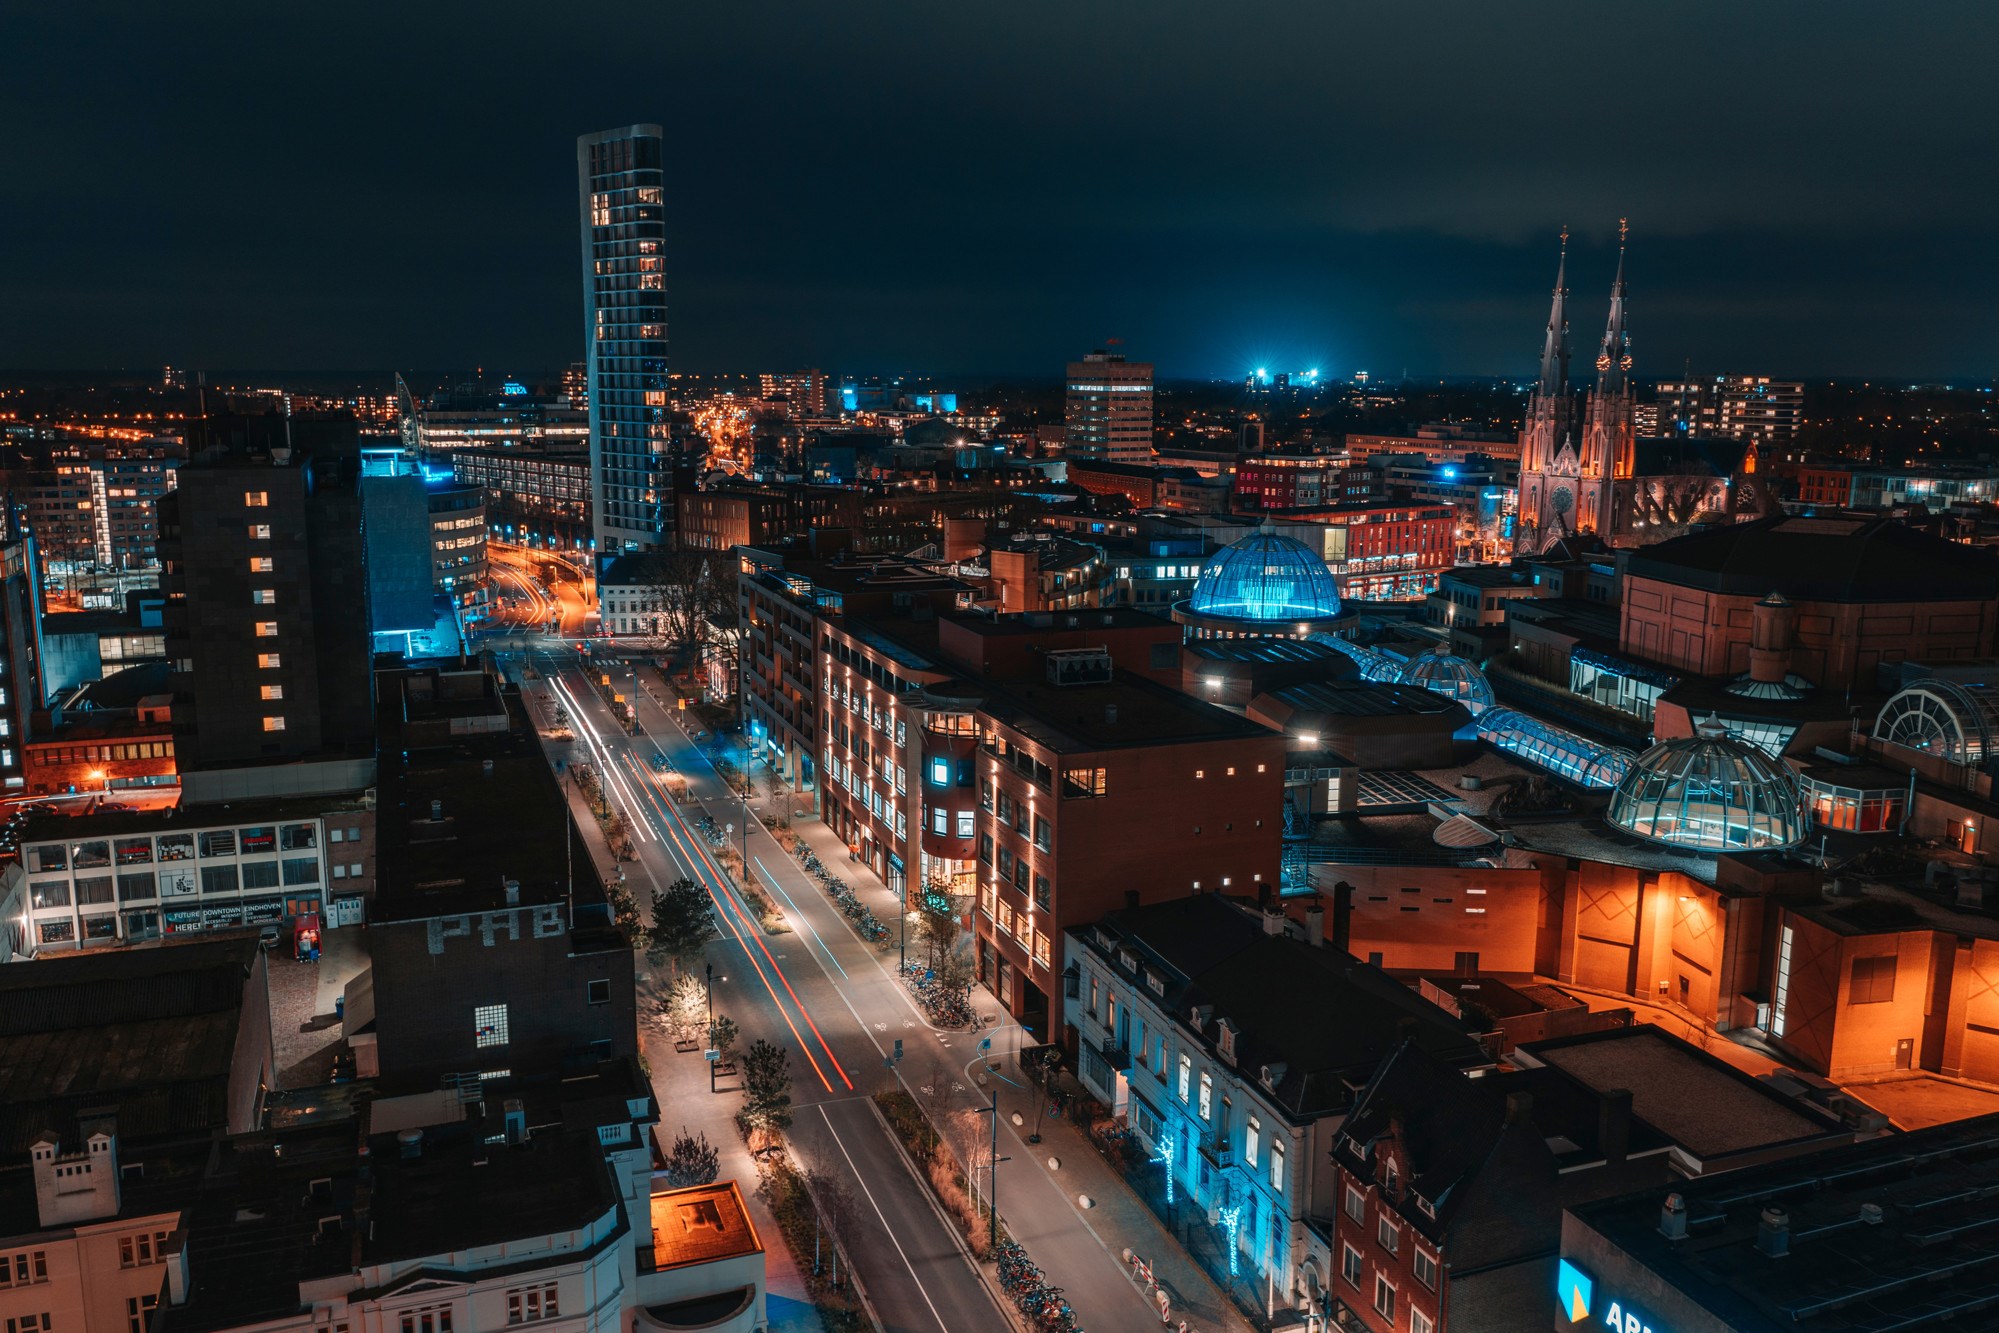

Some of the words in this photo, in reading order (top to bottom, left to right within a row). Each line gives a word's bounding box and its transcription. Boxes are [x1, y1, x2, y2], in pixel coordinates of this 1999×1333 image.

[174, 911, 200, 919] FUTURE
[203, 907, 241, 916] DOWNTOWN
[244, 903, 281, 912] EINDHOVEN
[1605, 1302, 1652, 1333] AB
